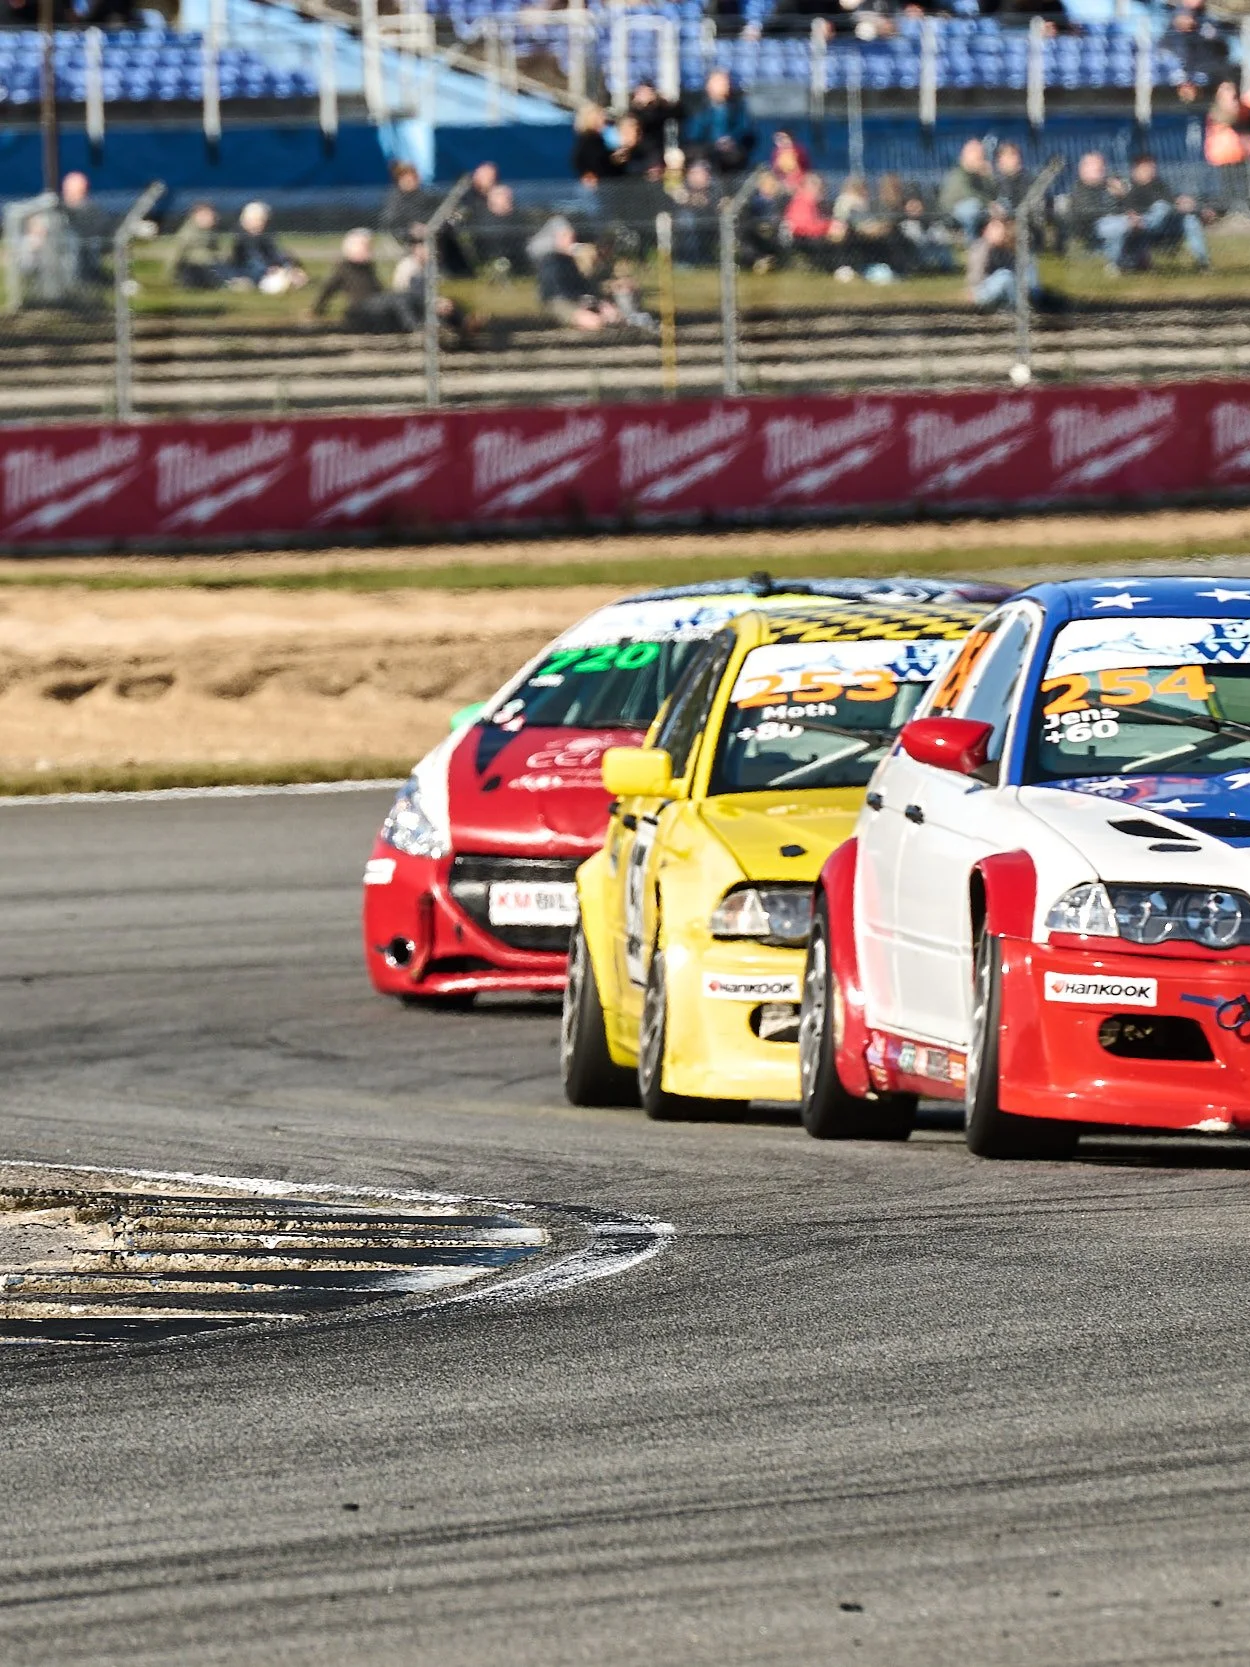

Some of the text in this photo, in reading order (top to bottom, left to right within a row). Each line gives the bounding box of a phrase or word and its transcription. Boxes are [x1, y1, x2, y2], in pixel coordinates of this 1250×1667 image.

[737, 671, 898, 710] 253
[1040, 664, 1216, 716] 254
[762, 702, 838, 720] Moth
[1044, 707, 1120, 730] Jens
[1045, 718, 1120, 744] +60
